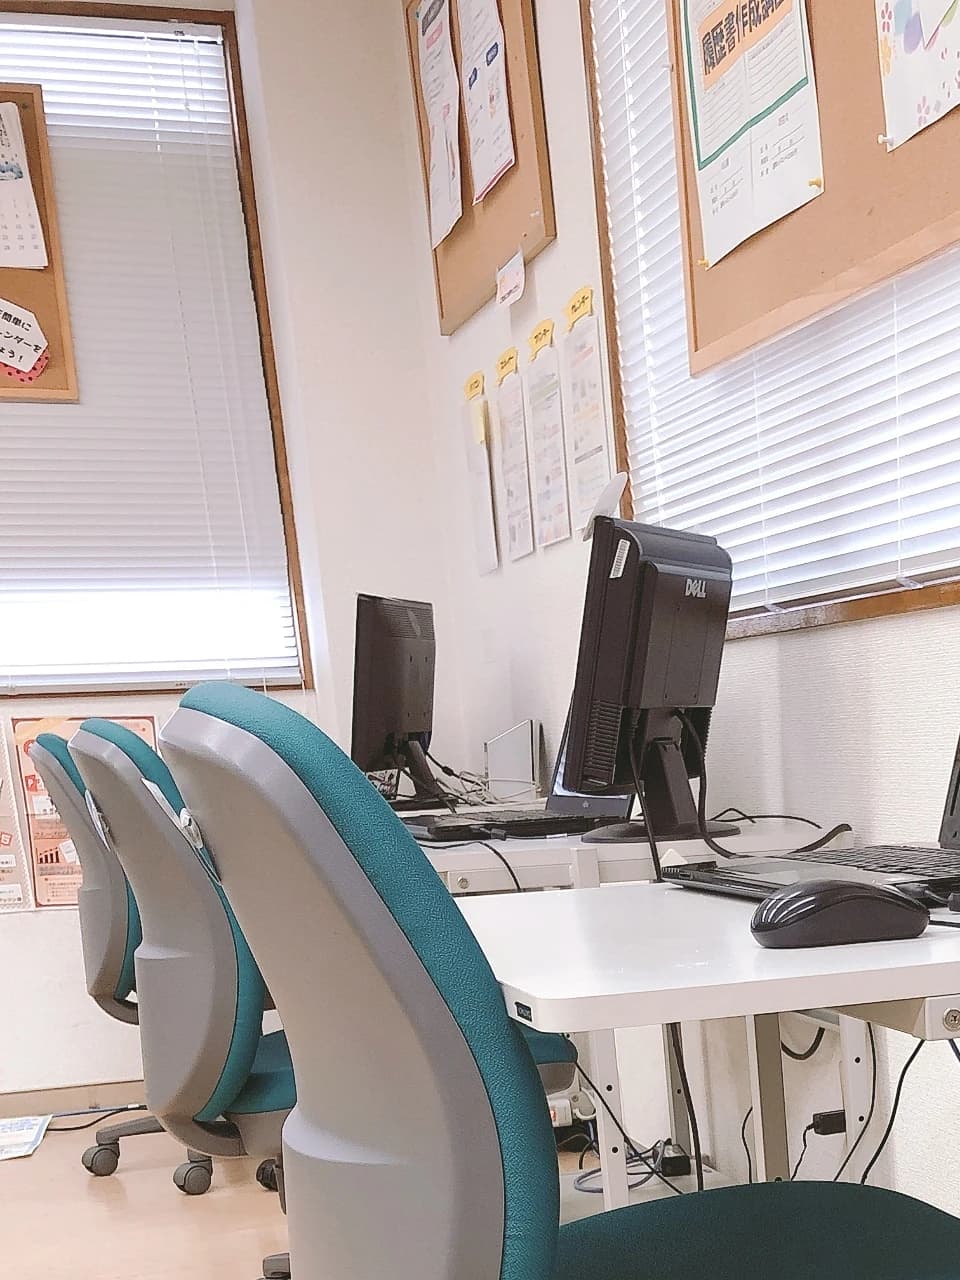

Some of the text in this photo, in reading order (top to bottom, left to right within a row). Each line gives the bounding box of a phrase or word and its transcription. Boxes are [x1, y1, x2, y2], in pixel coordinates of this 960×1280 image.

[0, 309, 32, 332] 簡単に
[685, 578, 706, 598] DELL
